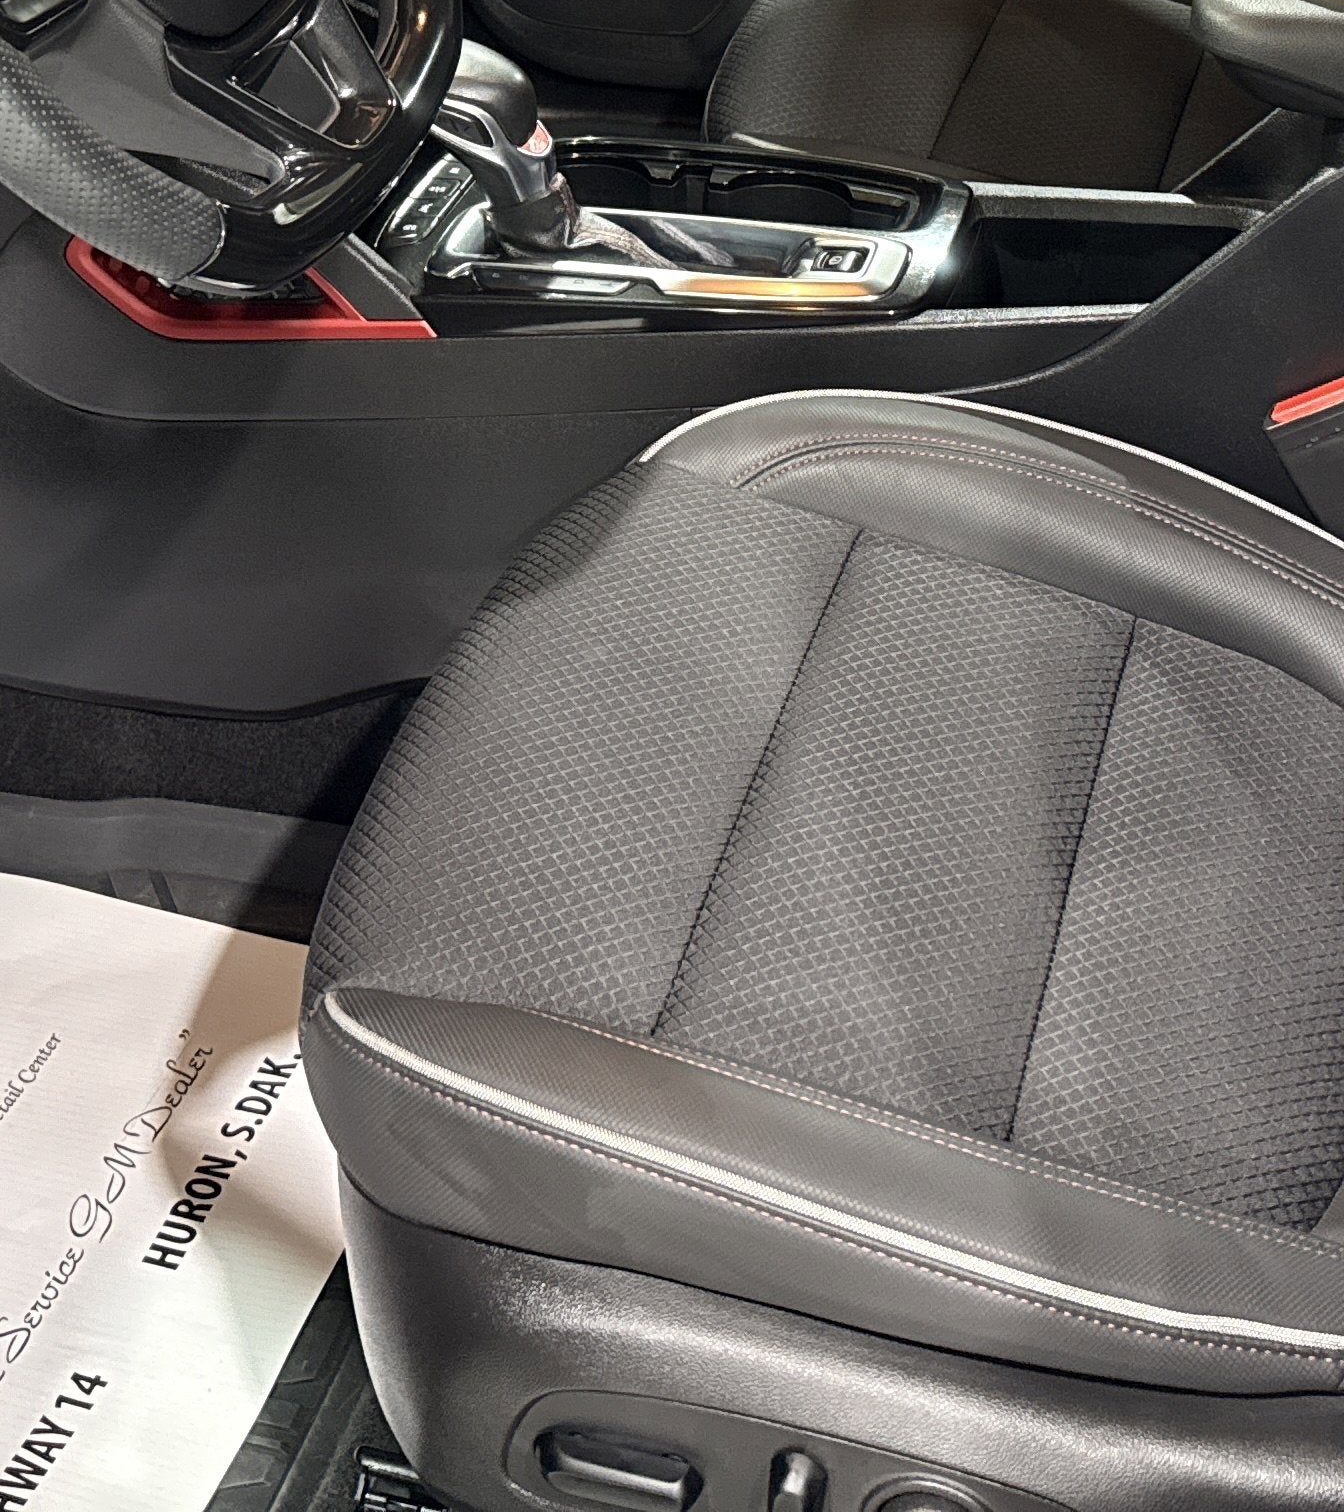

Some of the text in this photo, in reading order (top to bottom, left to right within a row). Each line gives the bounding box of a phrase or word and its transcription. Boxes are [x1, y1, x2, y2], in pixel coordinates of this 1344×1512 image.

[18, 1031, 63, 1085] Center
[142, 1149, 248, 1271] HURON,
[55, 1372, 108, 1410] 14
